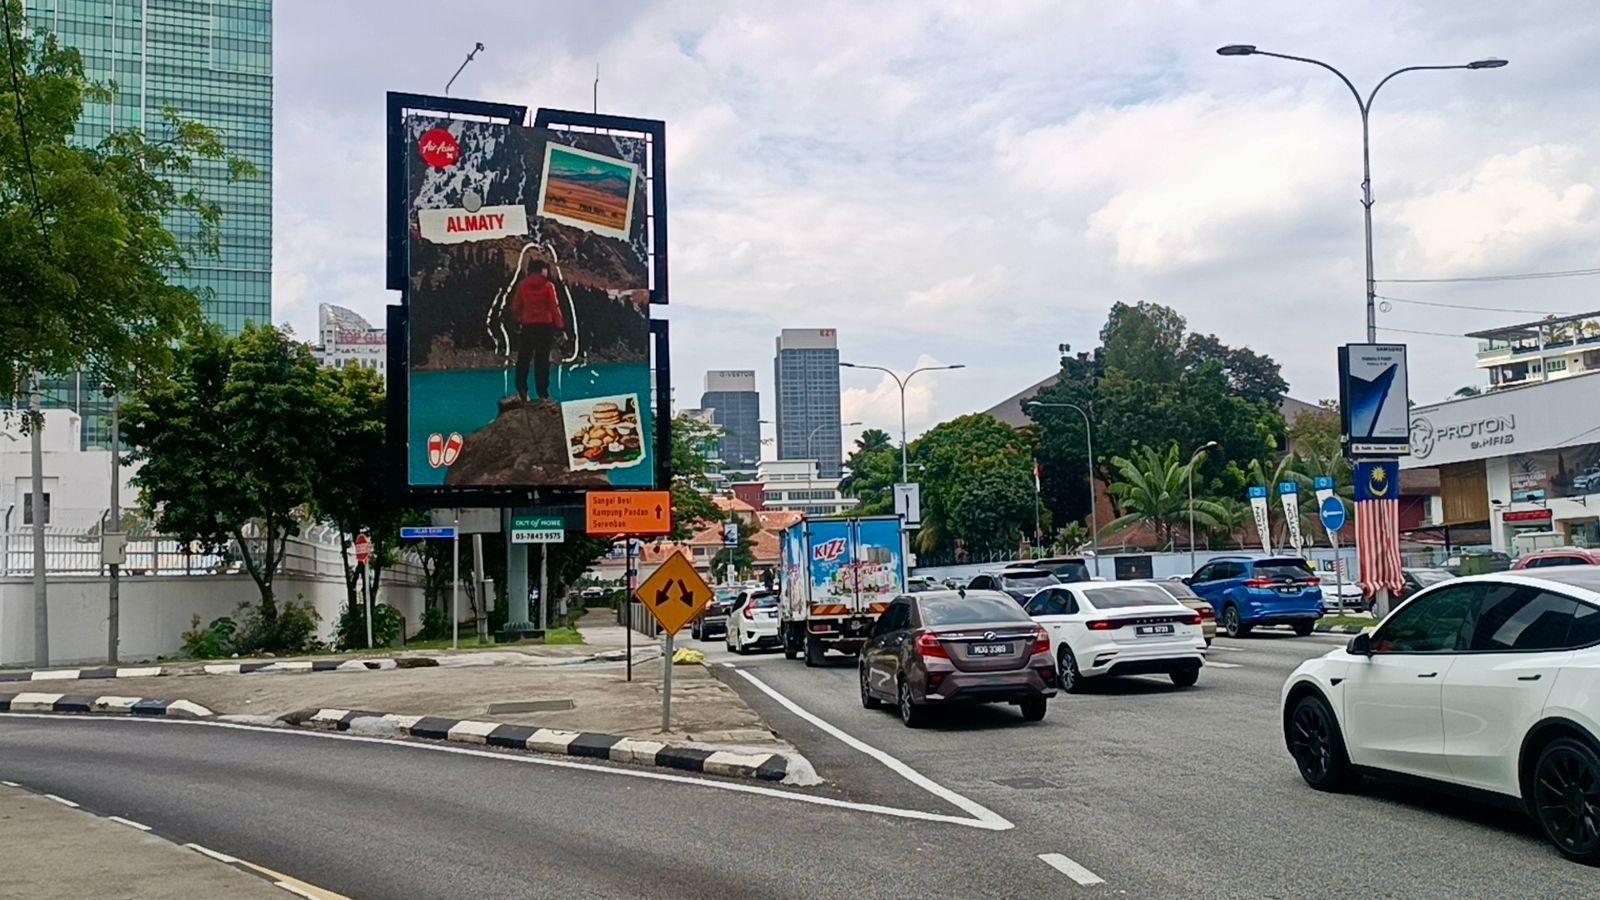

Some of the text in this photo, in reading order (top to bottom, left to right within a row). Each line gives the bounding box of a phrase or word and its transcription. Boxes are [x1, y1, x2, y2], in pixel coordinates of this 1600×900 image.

[447, 214, 504, 232] ALMATY
[340, 331, 360, 344] TOP
[1437, 413, 1515, 442] PROTON
[592, 496, 615, 506] Sungai
[592, 507, 649, 518] Kampung Pandan
[592, 519, 626, 528] Seremban
[544, 532, 561, 540] 9575
[814, 539, 845, 559] KIZZ
